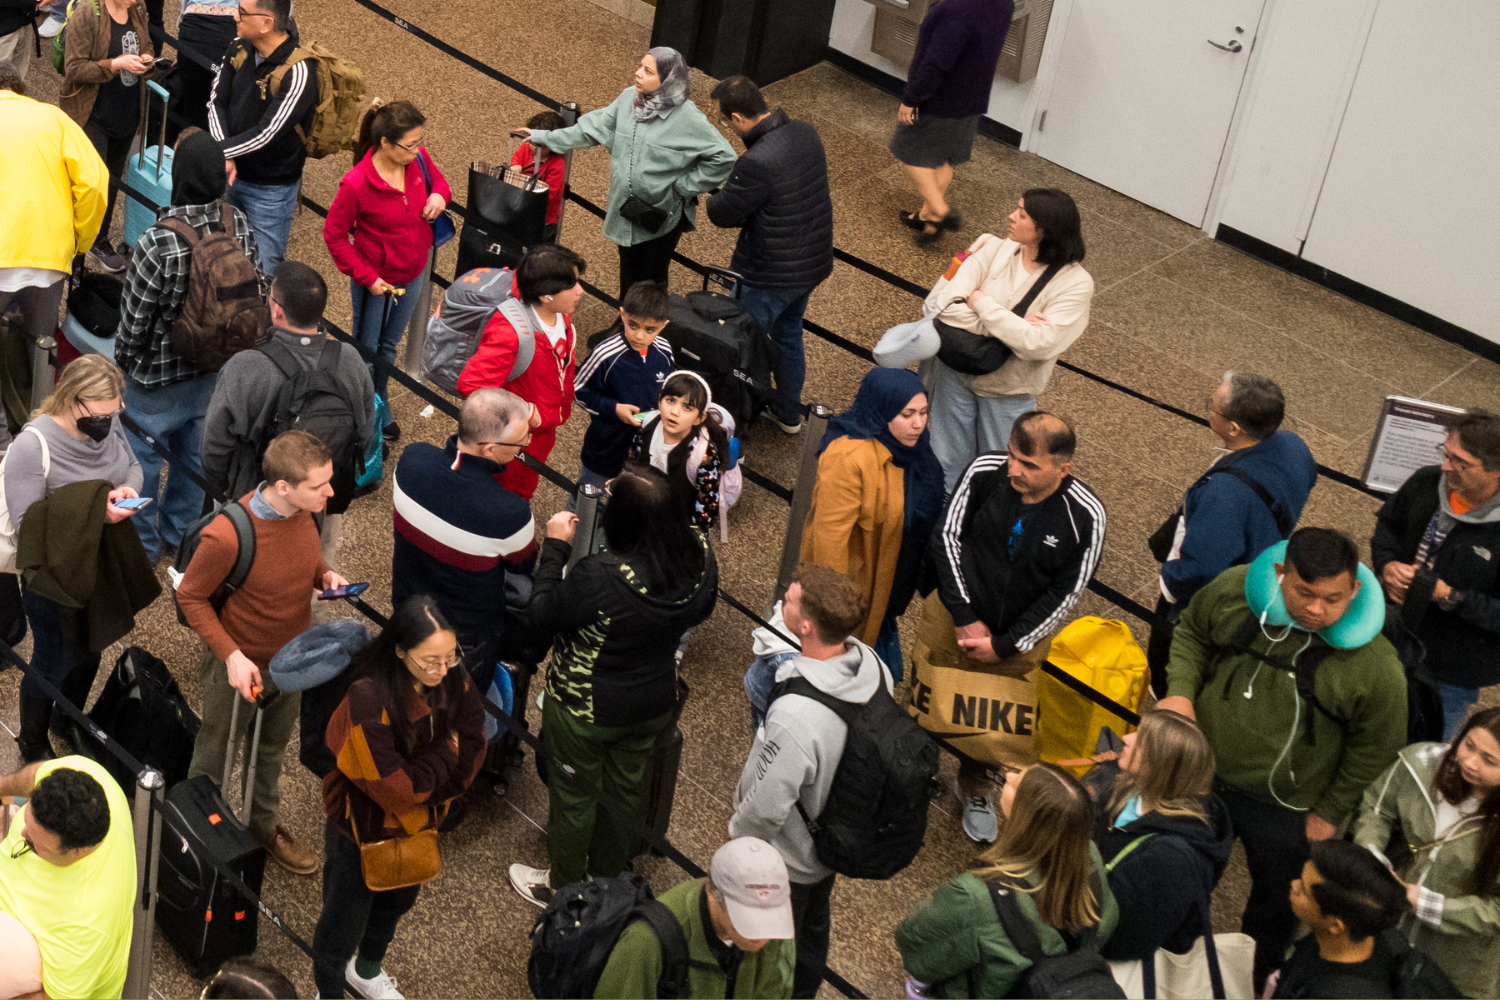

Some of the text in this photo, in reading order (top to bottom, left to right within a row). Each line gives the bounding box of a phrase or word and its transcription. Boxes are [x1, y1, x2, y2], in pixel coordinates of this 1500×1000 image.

[394, 16, 409, 30] SEA
[211, 63, 221, 74] SE
[733, 368, 754, 386] SEA
[951, 692, 1033, 735] NIKE
[258, 900, 281, 927] SEA
